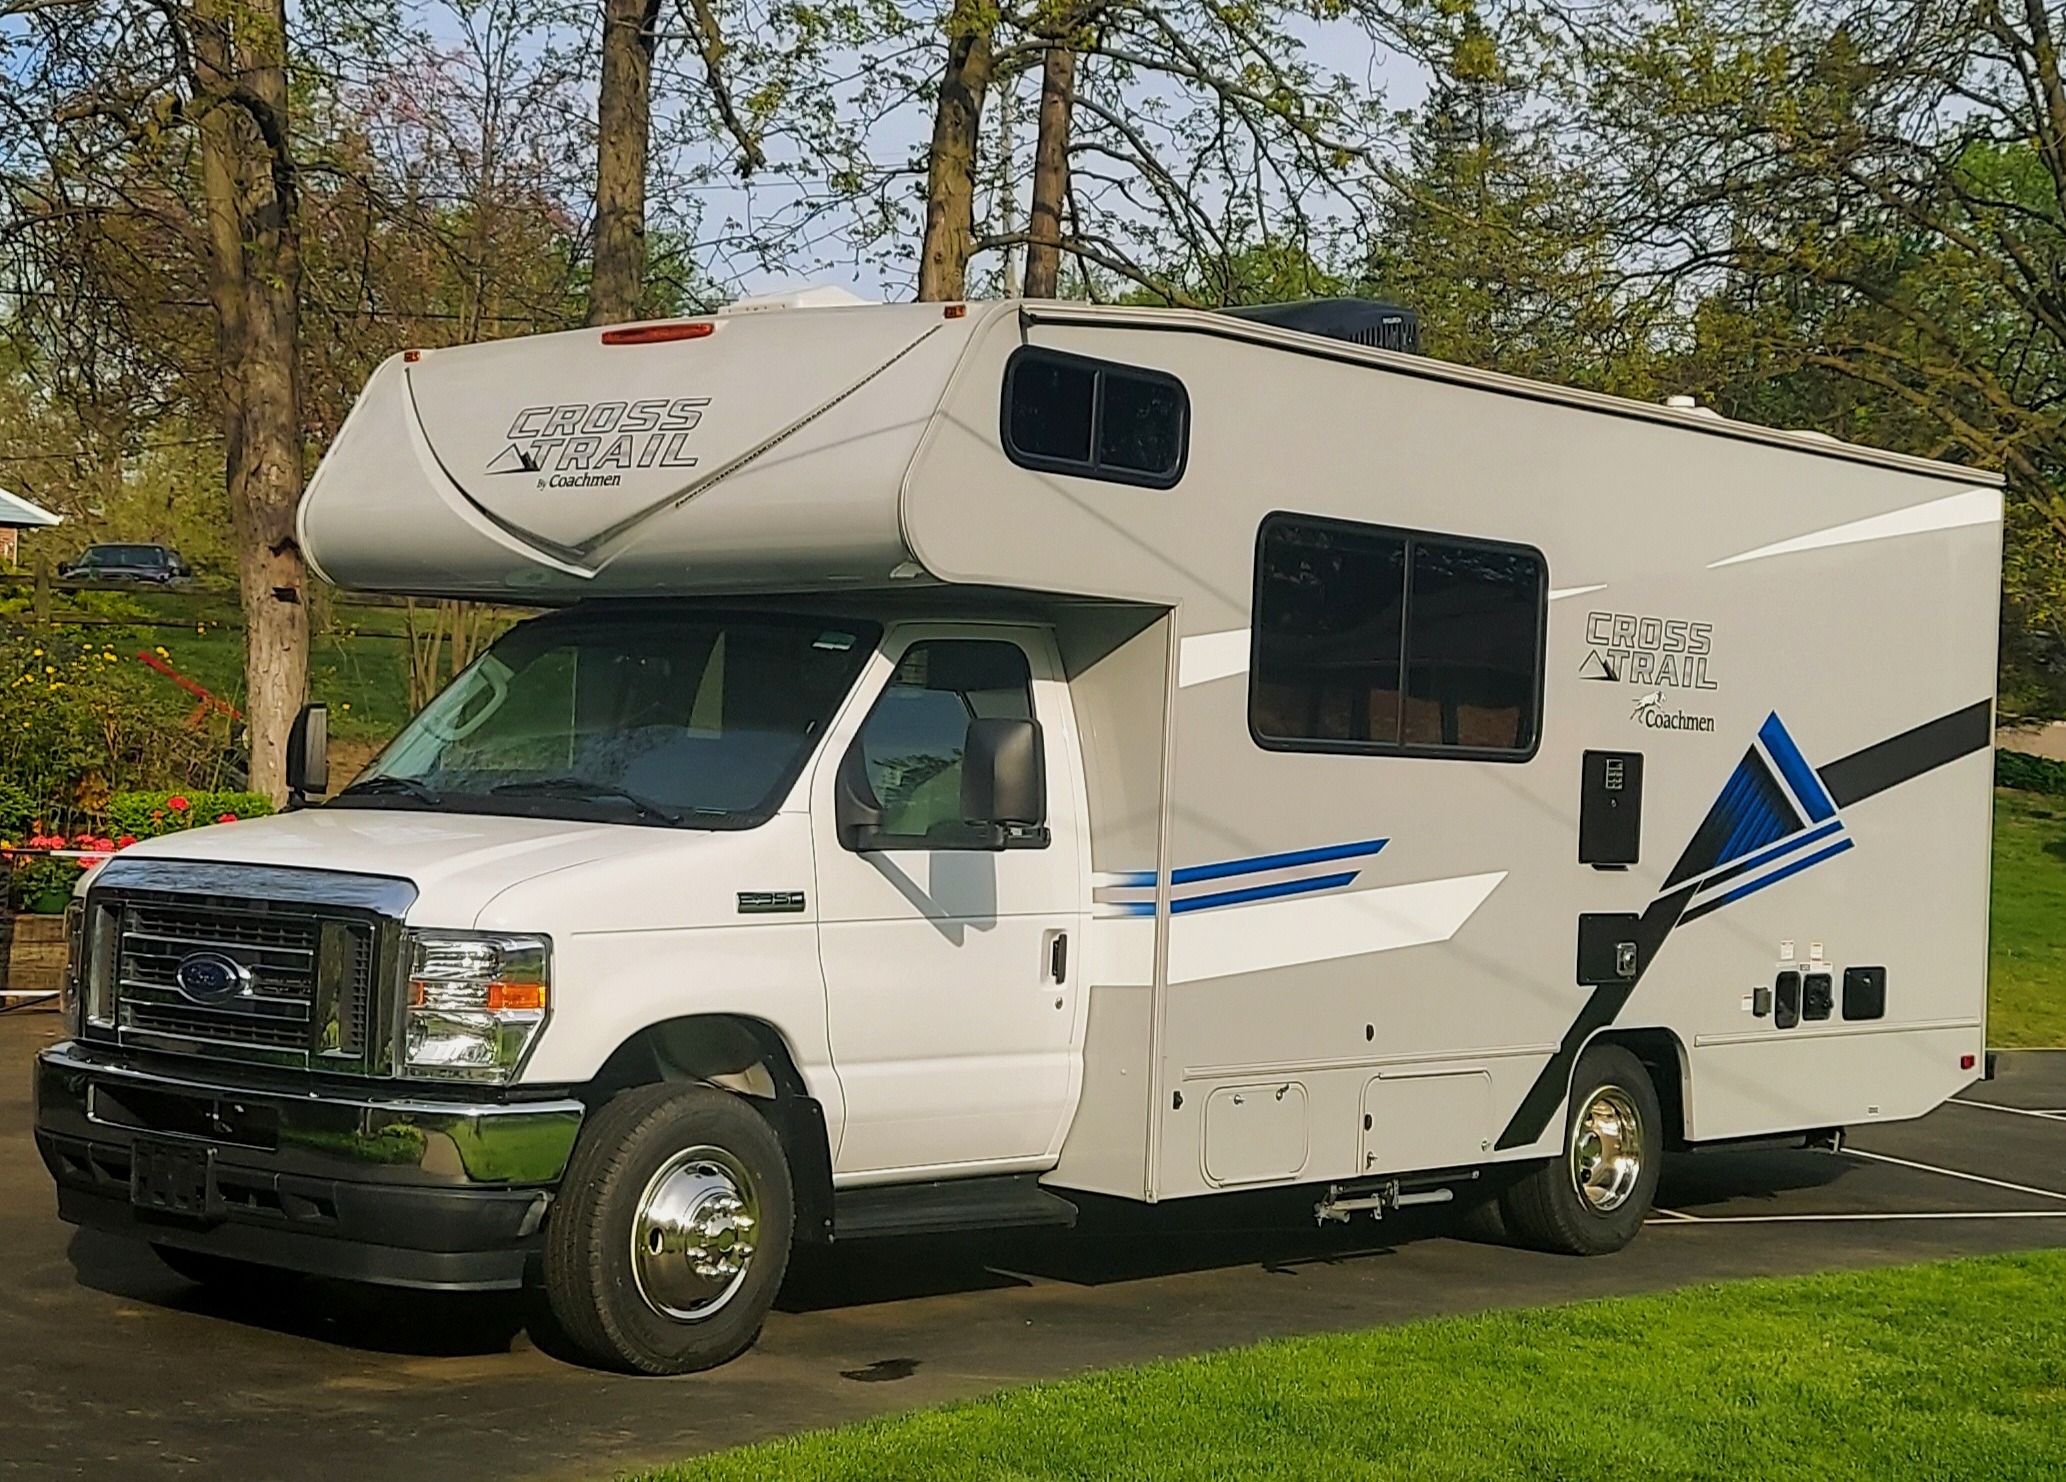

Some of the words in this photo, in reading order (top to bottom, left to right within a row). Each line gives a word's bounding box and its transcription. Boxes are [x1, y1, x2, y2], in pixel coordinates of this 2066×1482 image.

[507, 397, 713, 439] CROSS
[530, 432, 699, 472] TRAIL
[537, 478, 547, 491] By
[549, 473, 621, 488] Coachmen
[1586, 611, 1713, 655] CROSS
[1606, 648, 1718, 690] TRAIL
[1645, 709, 1715, 732] Coachmen
